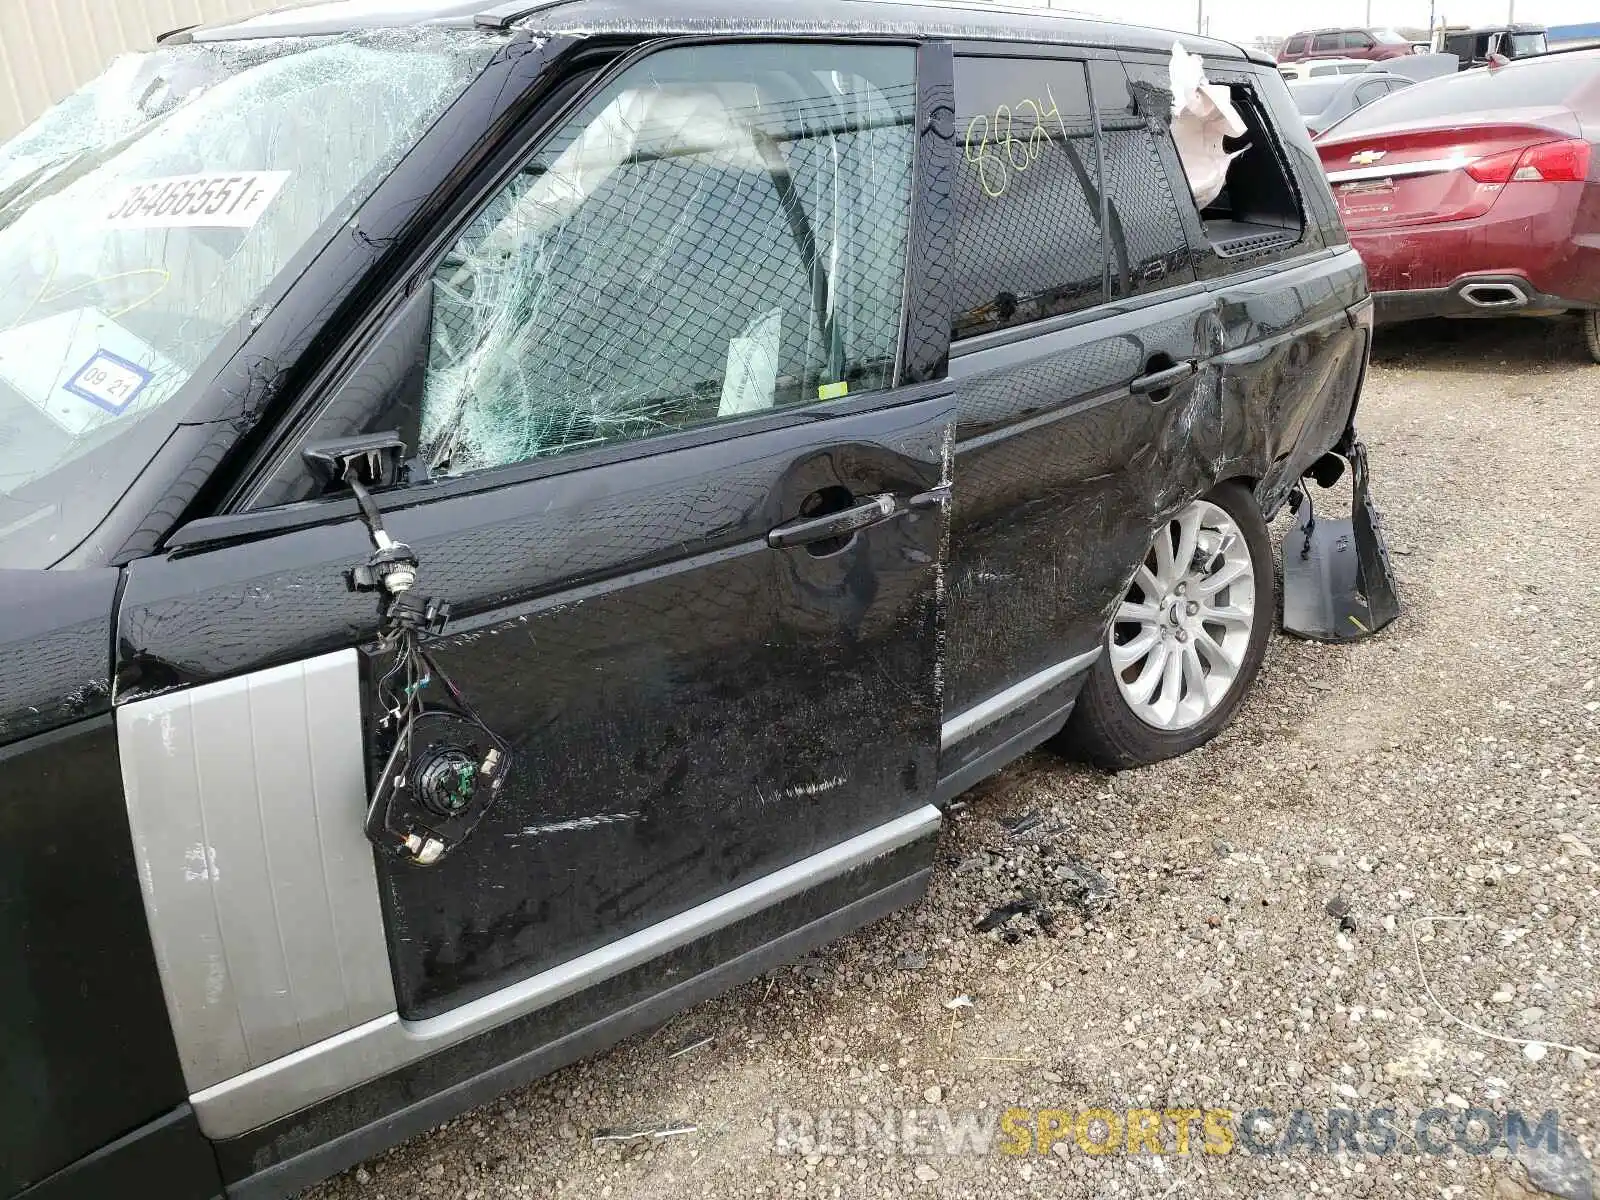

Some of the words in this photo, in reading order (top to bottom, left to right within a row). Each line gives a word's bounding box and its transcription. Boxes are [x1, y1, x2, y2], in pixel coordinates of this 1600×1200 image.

[965, 82, 1068, 197] 8824
[83, 367, 107, 386] 09
[106, 379, 132, 399] 21
